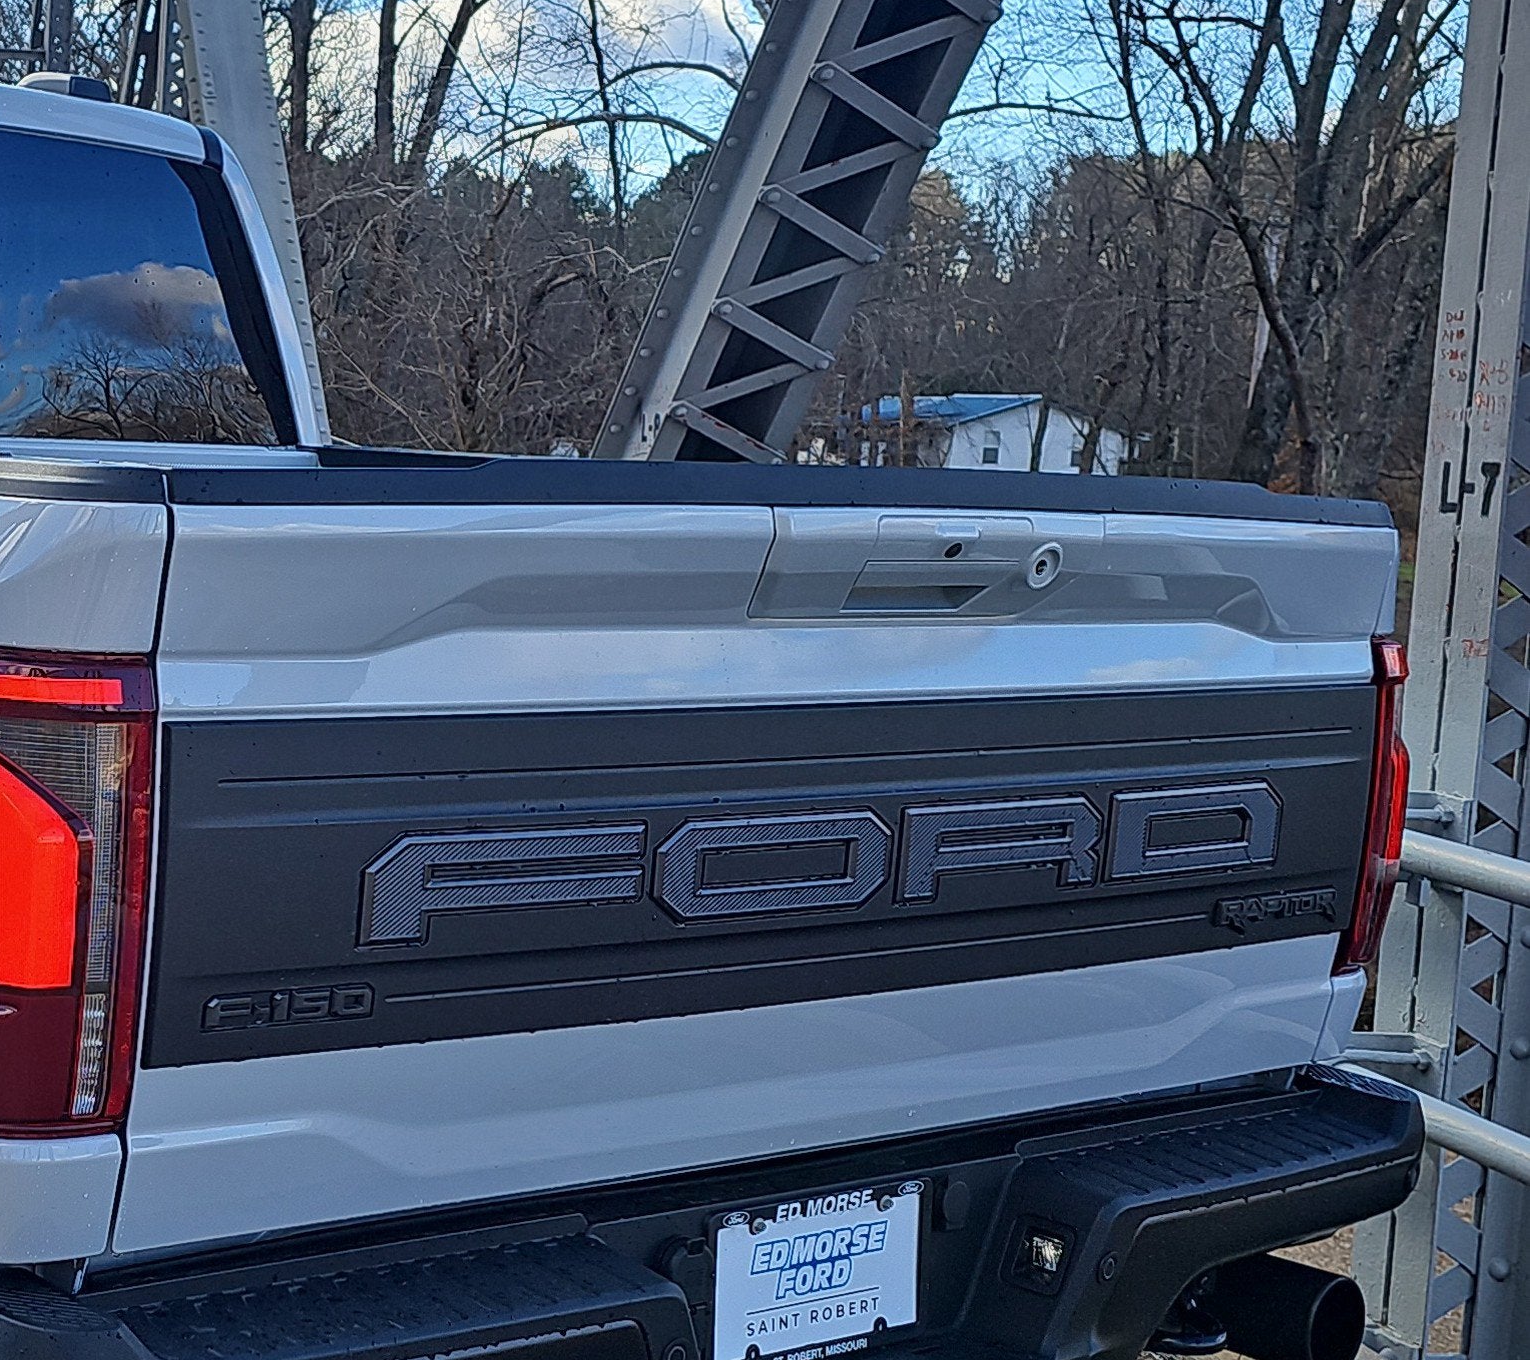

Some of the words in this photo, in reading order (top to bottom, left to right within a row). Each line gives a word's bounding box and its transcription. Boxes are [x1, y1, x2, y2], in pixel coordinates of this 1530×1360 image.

[356, 777, 1284, 951] FORD
[1214, 886, 1337, 937] RAPTOR
[201, 982, 375, 1033] F-150
[776, 1202, 802, 1223] ED
[806, 1189, 874, 1218] MORSE
[750, 1239, 791, 1275] ED
[788, 1220, 888, 1267] MORSE
[776, 1256, 853, 1300] FORD
[746, 1313, 801, 1337] SAINT
[810, 1297, 880, 1324] ROBERT
[825, 1338, 868, 1357] MISSOURI
